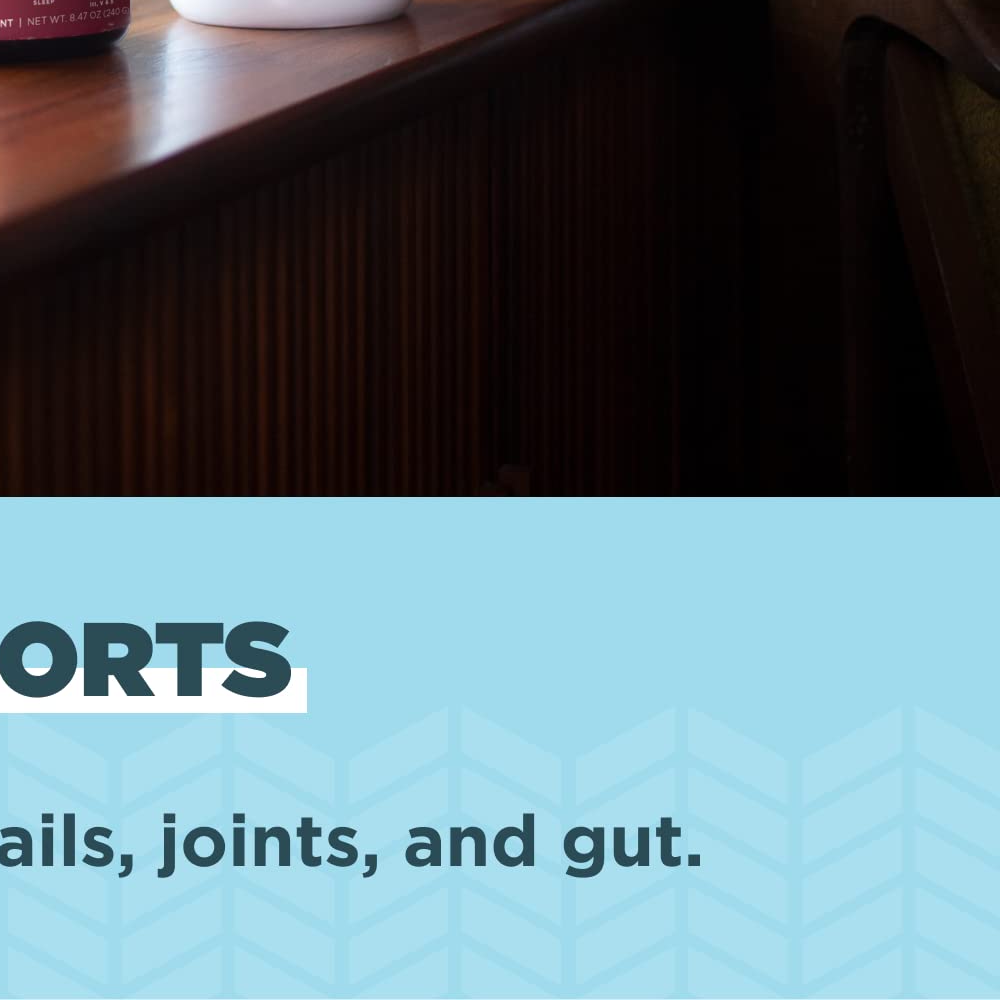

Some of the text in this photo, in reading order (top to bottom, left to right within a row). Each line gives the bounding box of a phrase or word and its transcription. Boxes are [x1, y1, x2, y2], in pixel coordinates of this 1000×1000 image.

[27, 16, 47, 26] NET
[49, 14, 68, 25] WT.
[69, 12, 88, 22] 8.47
[89, 10, 102, 20] OZ
[103, 7, 121, 19] (240
